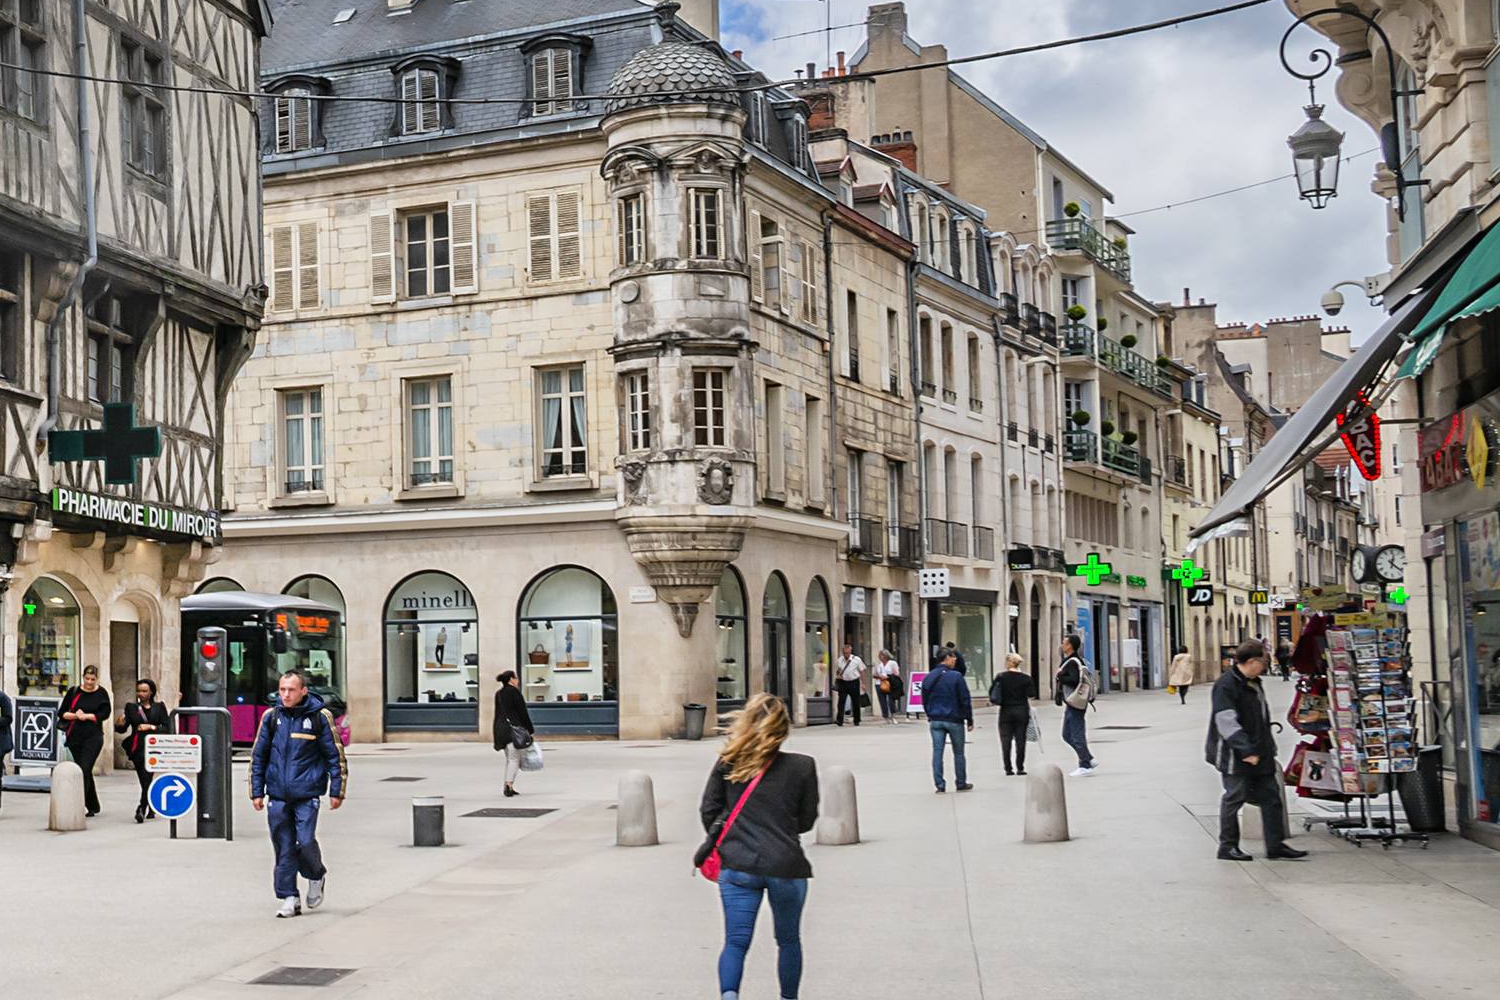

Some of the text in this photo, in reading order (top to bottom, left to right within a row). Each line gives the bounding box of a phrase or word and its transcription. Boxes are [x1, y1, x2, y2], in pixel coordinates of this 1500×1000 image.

[58, 488, 217, 538] PHARMACIE DU MIROIR
[1191, 589, 1211, 602] JD
